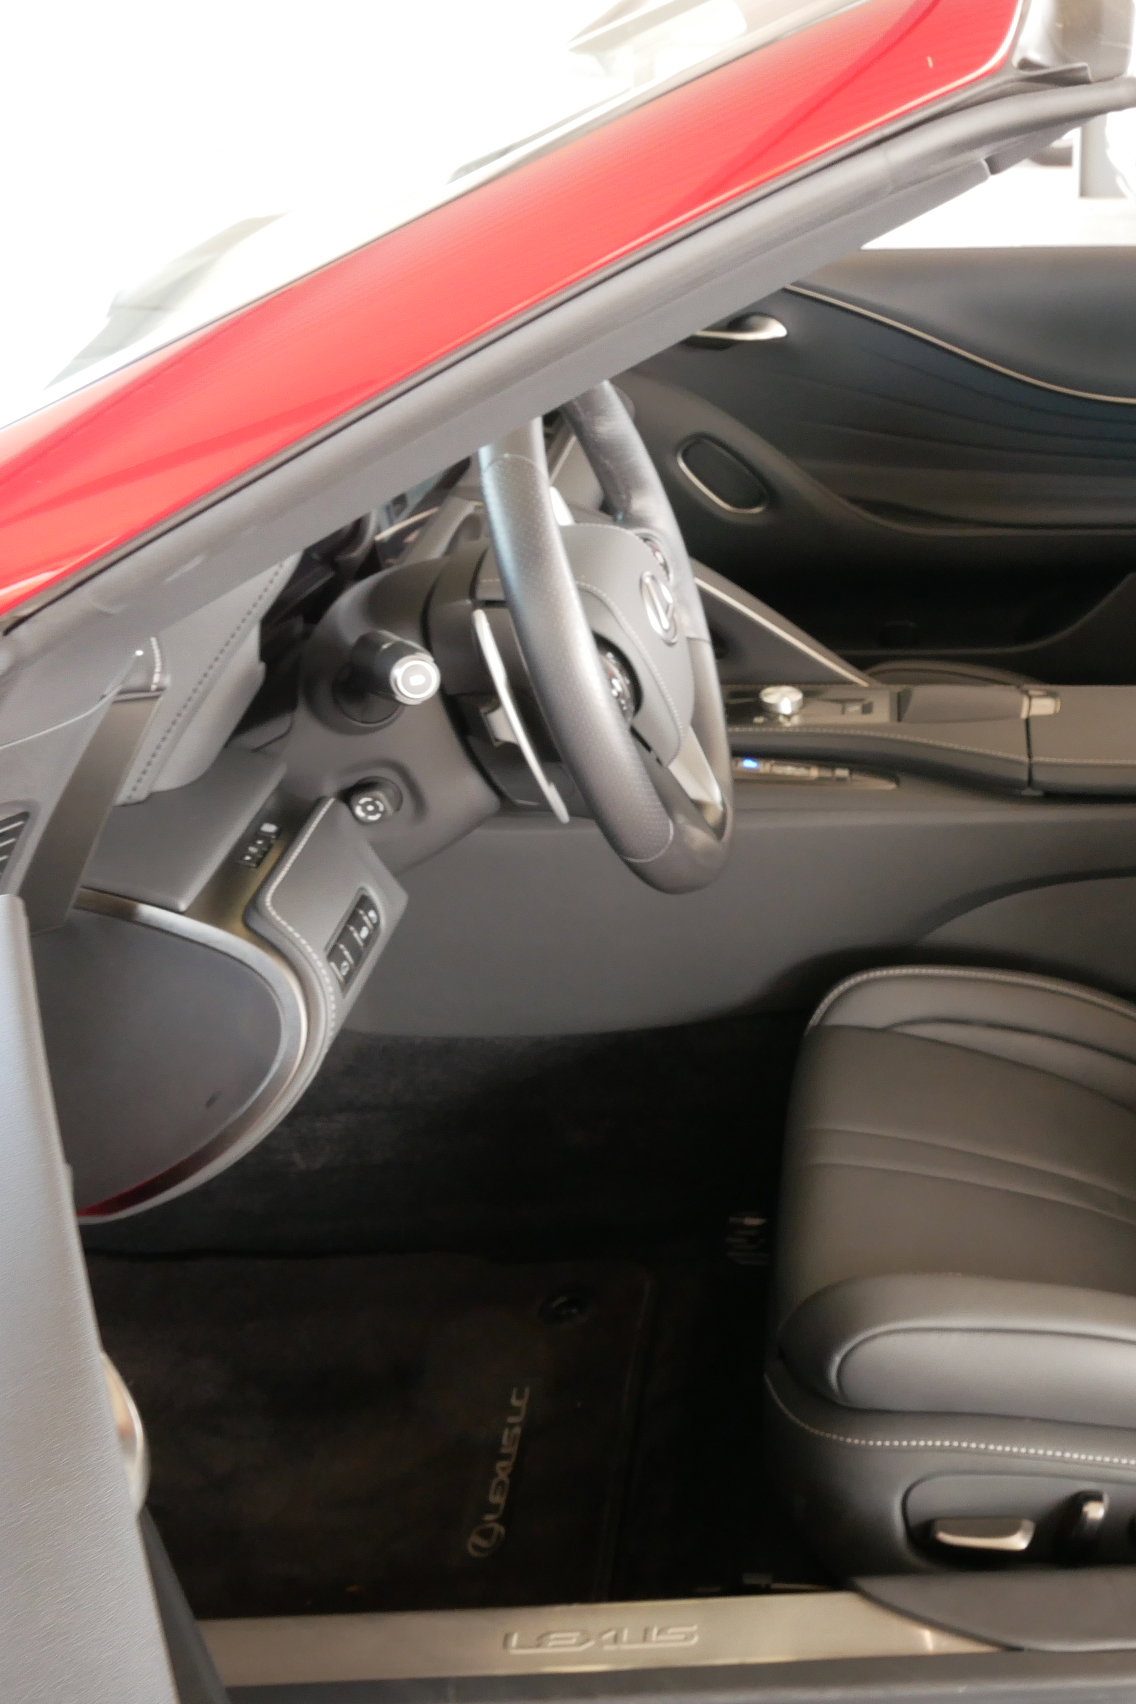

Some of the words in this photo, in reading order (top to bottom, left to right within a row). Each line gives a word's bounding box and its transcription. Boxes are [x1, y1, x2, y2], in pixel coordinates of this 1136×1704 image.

[481, 1425, 522, 1521] LEXUS
[506, 1386, 530, 1423] LC
[503, 1623, 699, 1656] LEXUS
